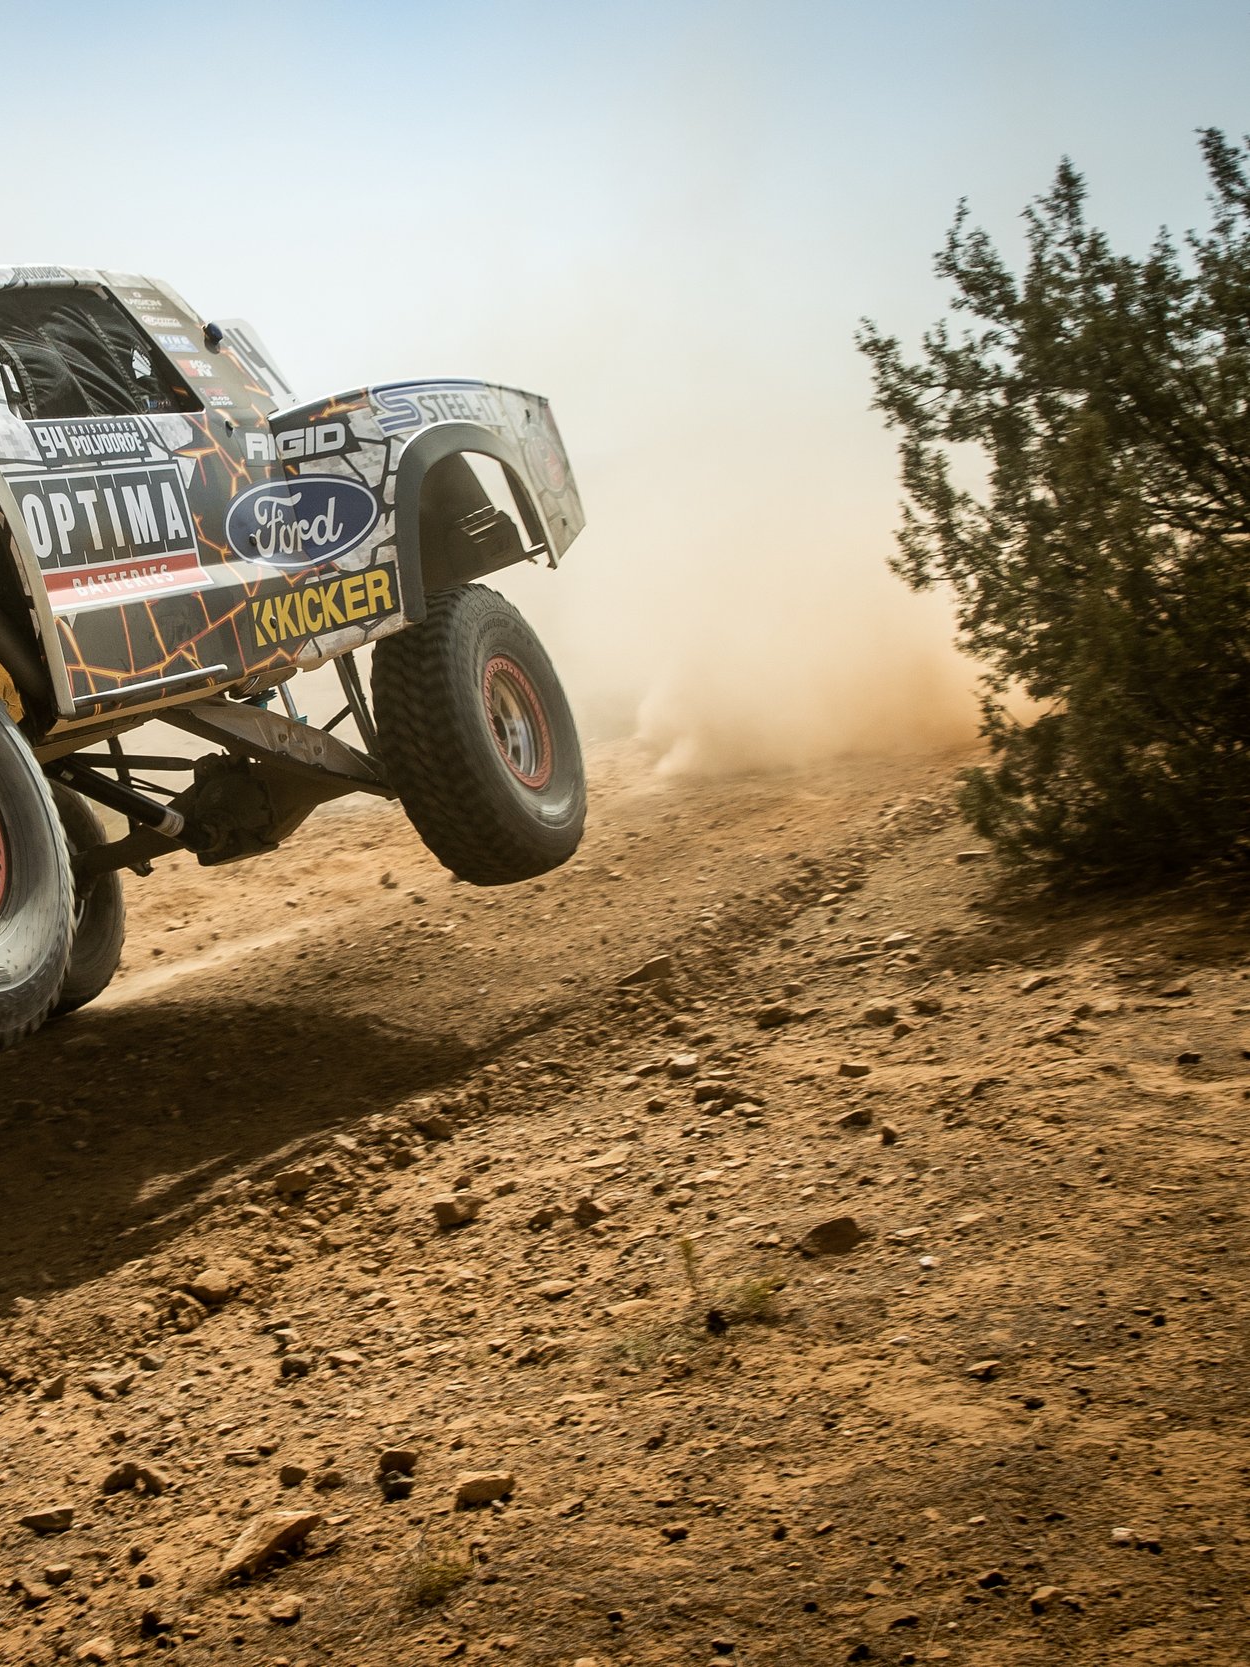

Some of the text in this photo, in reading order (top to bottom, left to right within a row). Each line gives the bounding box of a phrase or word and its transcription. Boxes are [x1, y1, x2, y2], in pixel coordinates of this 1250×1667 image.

[33, 425, 73, 459] 94
[64, 421, 137, 436] CHRISTOPHER
[69, 431, 145, 457] POLVOORDE
[244, 422, 346, 461] RIGID
[21, 481, 188, 559] OPTIMA
[253, 491, 344, 558] Ford
[72, 563, 176, 597] BATTERIES
